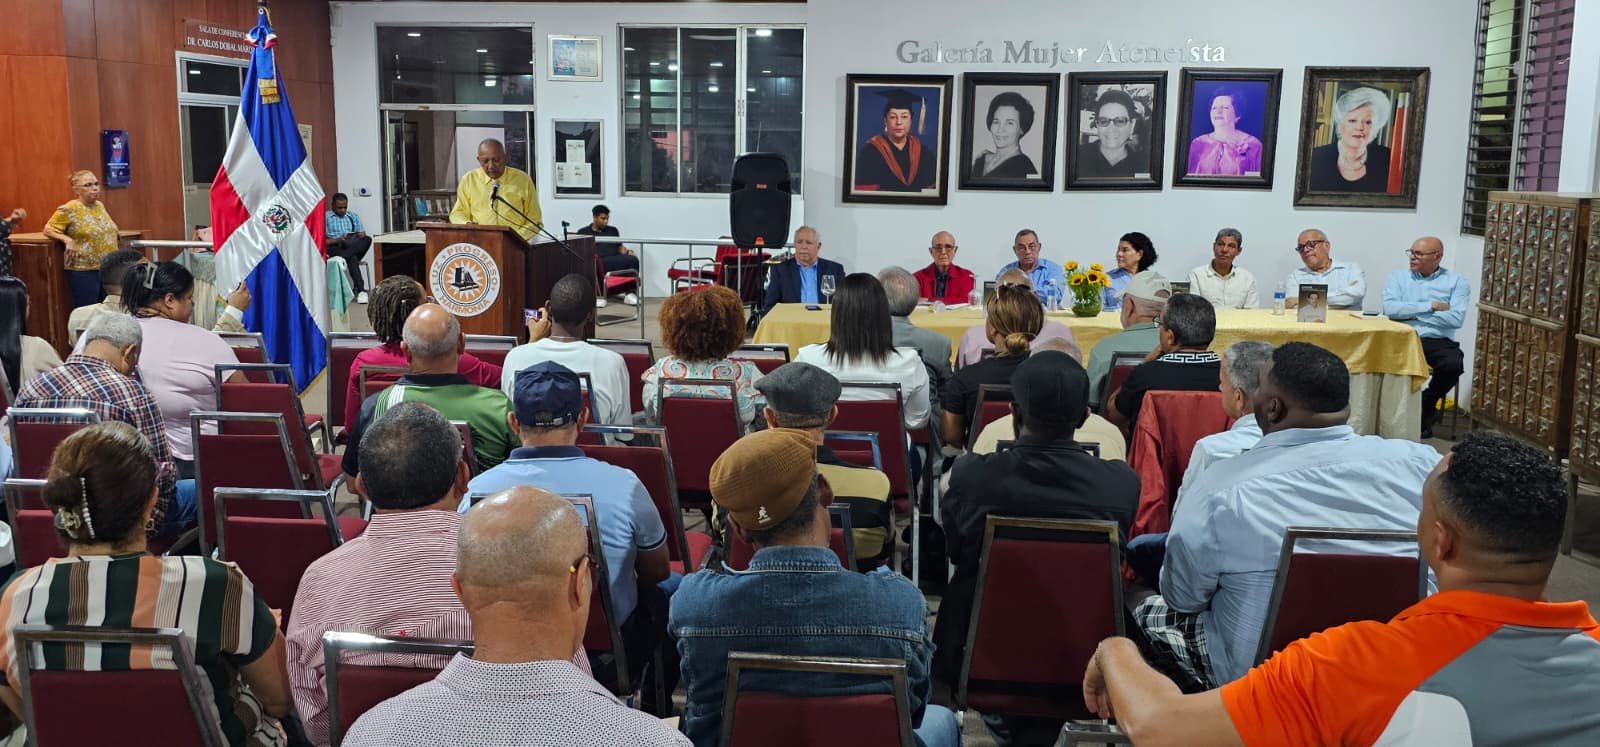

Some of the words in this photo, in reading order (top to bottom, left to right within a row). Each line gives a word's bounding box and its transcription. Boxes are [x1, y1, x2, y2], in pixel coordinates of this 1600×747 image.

[197, 38, 219, 49] CARLOS
[896, 39, 993, 64] Galería
[1003, 40, 1087, 69] Mujer
[1096, 39, 1225, 64] Ateneísta
[432, 261, 441, 285] LUZ
[447, 245, 498, 286] PROGRESO
